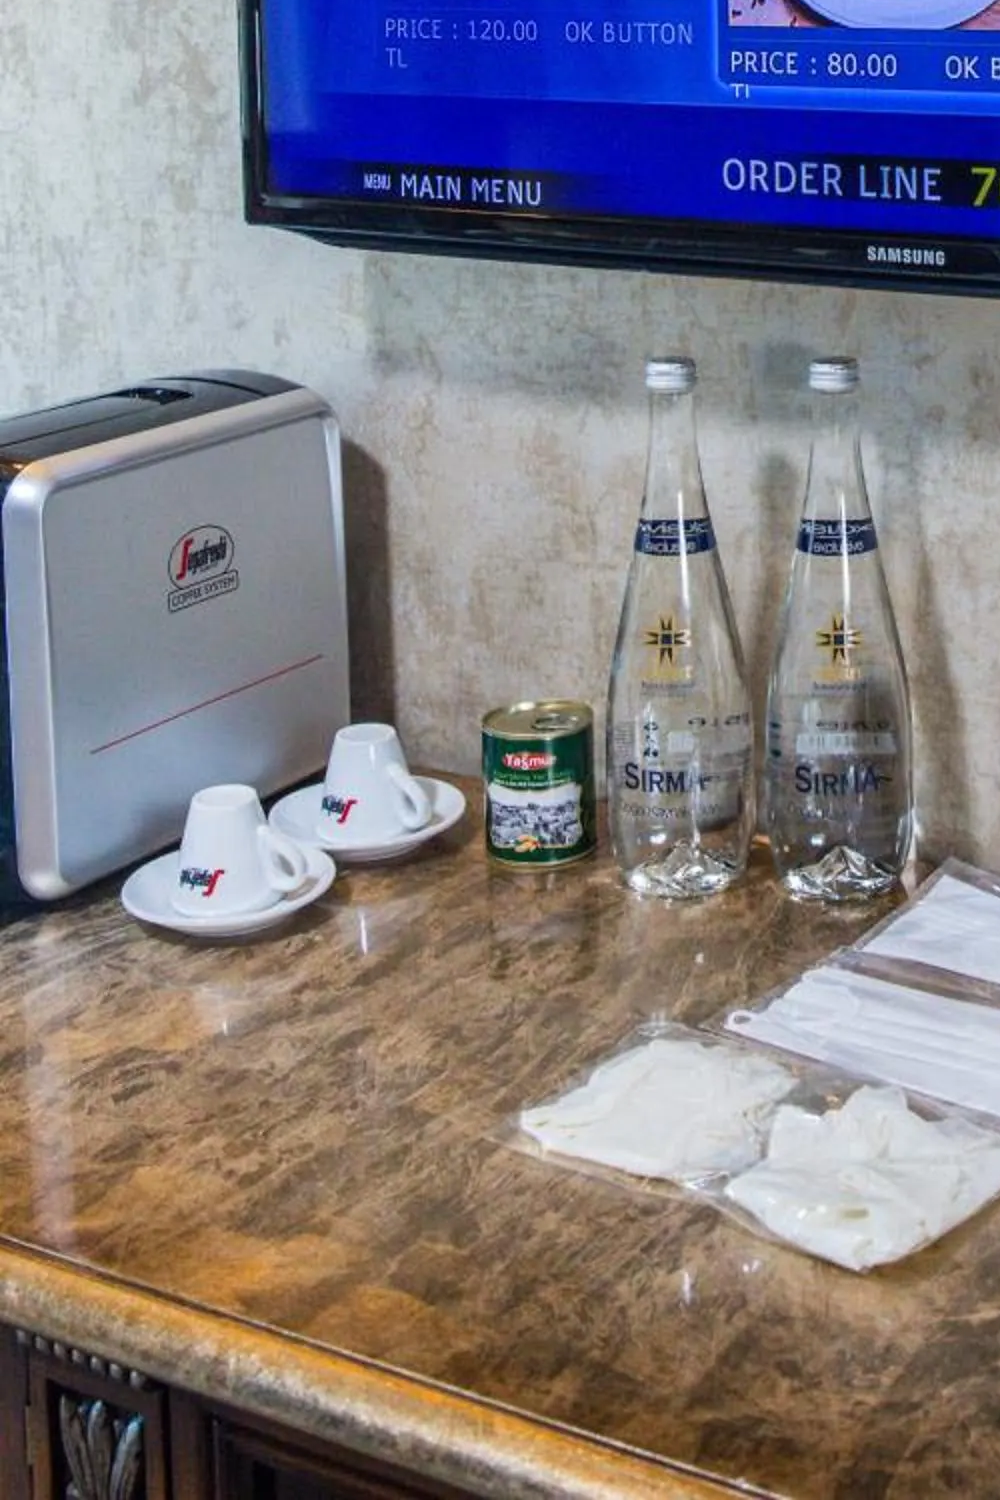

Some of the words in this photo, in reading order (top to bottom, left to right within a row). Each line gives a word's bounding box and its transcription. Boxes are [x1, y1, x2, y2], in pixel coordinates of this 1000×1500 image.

[385, 17, 442, 40] PRICE
[468, 19, 538, 42] 120.00
[565, 20, 593, 44] OK
[603, 22, 693, 45] BUTTON
[386, 47, 408, 69] TL
[730, 51, 799, 75] PRICE
[827, 53, 898, 77] 80.00
[945, 55, 980, 80] OK
[363, 172, 391, 191] MENU
[400, 173, 462, 201] MAIN
[471, 178, 543, 206] MENU
[722, 157, 844, 197] ORDER
[859, 164, 942, 201] LINE
[866, 245, 946, 267] SAMSUNG
